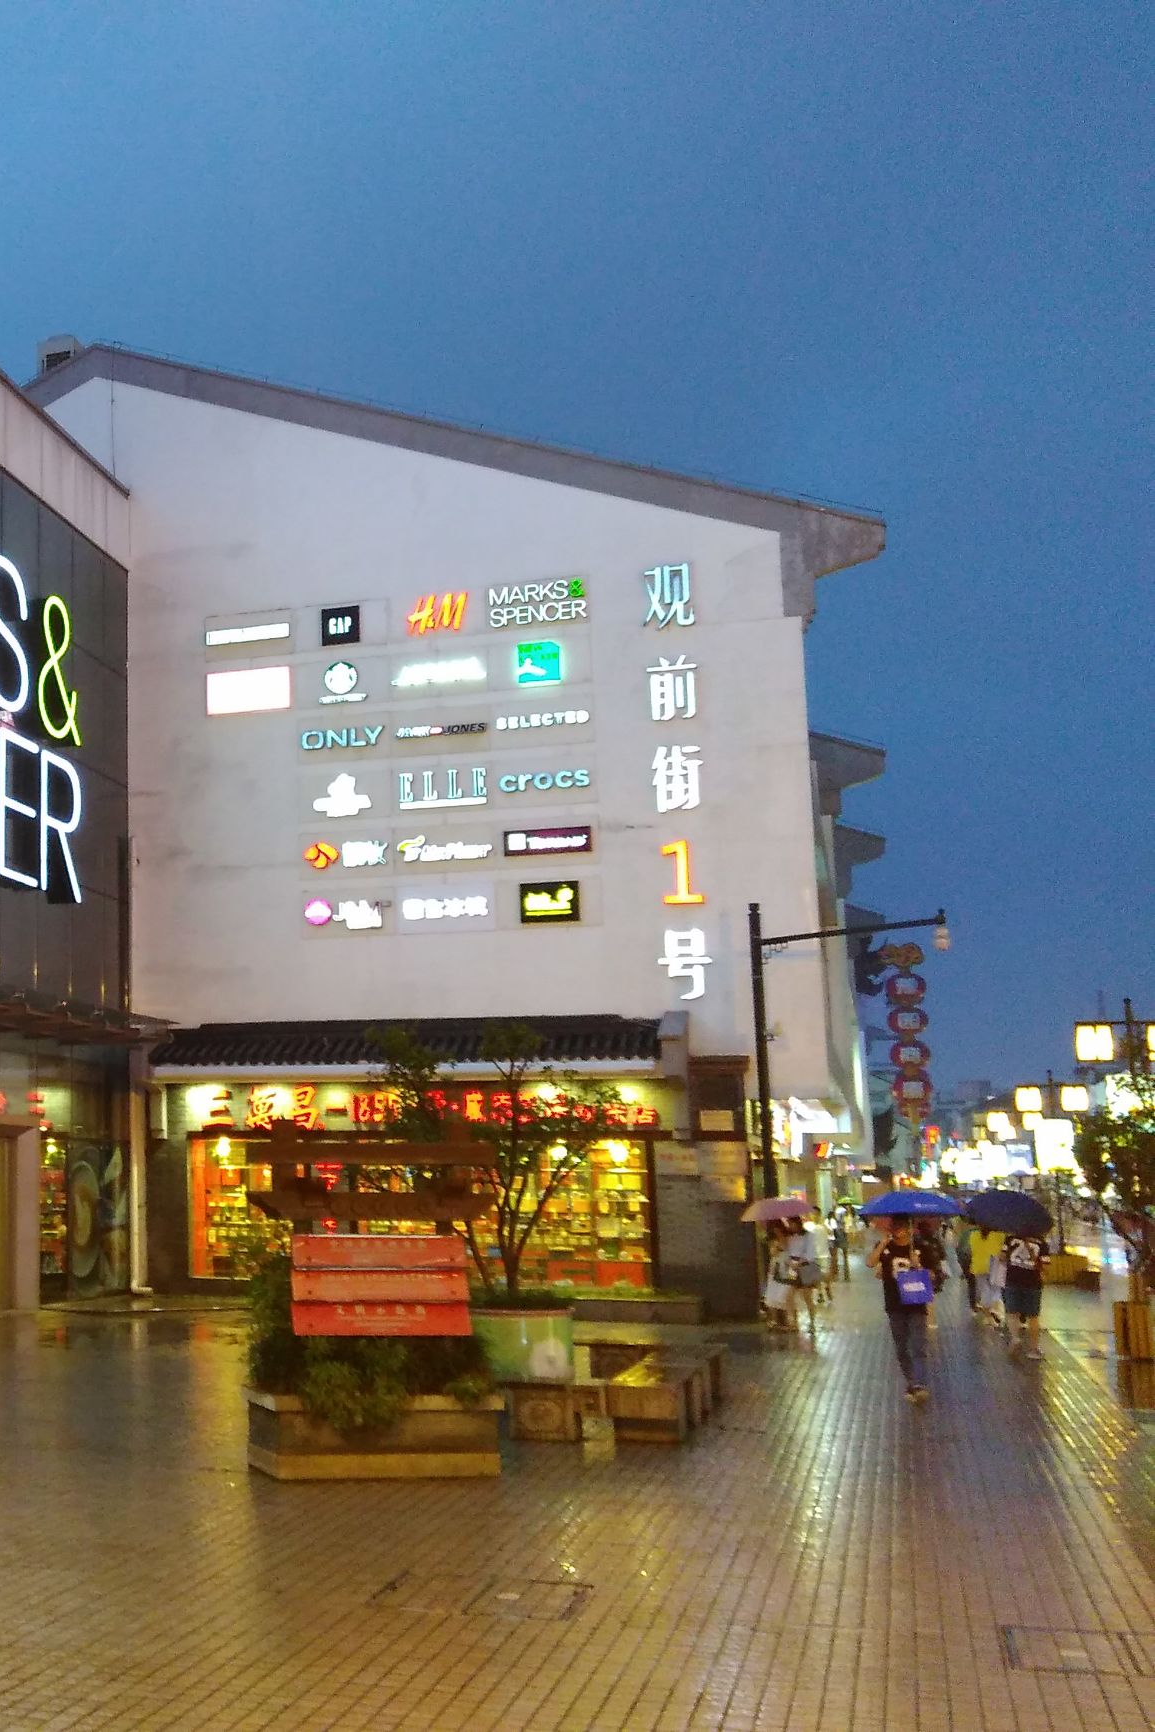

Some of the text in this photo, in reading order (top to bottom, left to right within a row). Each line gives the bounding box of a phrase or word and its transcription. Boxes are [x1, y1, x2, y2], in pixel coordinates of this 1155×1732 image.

[328, 616, 353, 636] GAP
[407, 590, 469, 636] H&M
[489, 599, 588, 629] SPENCER
[301, 725, 385, 751] ONLY
[398, 766, 488, 803] ELLE
[498, 768, 591, 794] crocs
